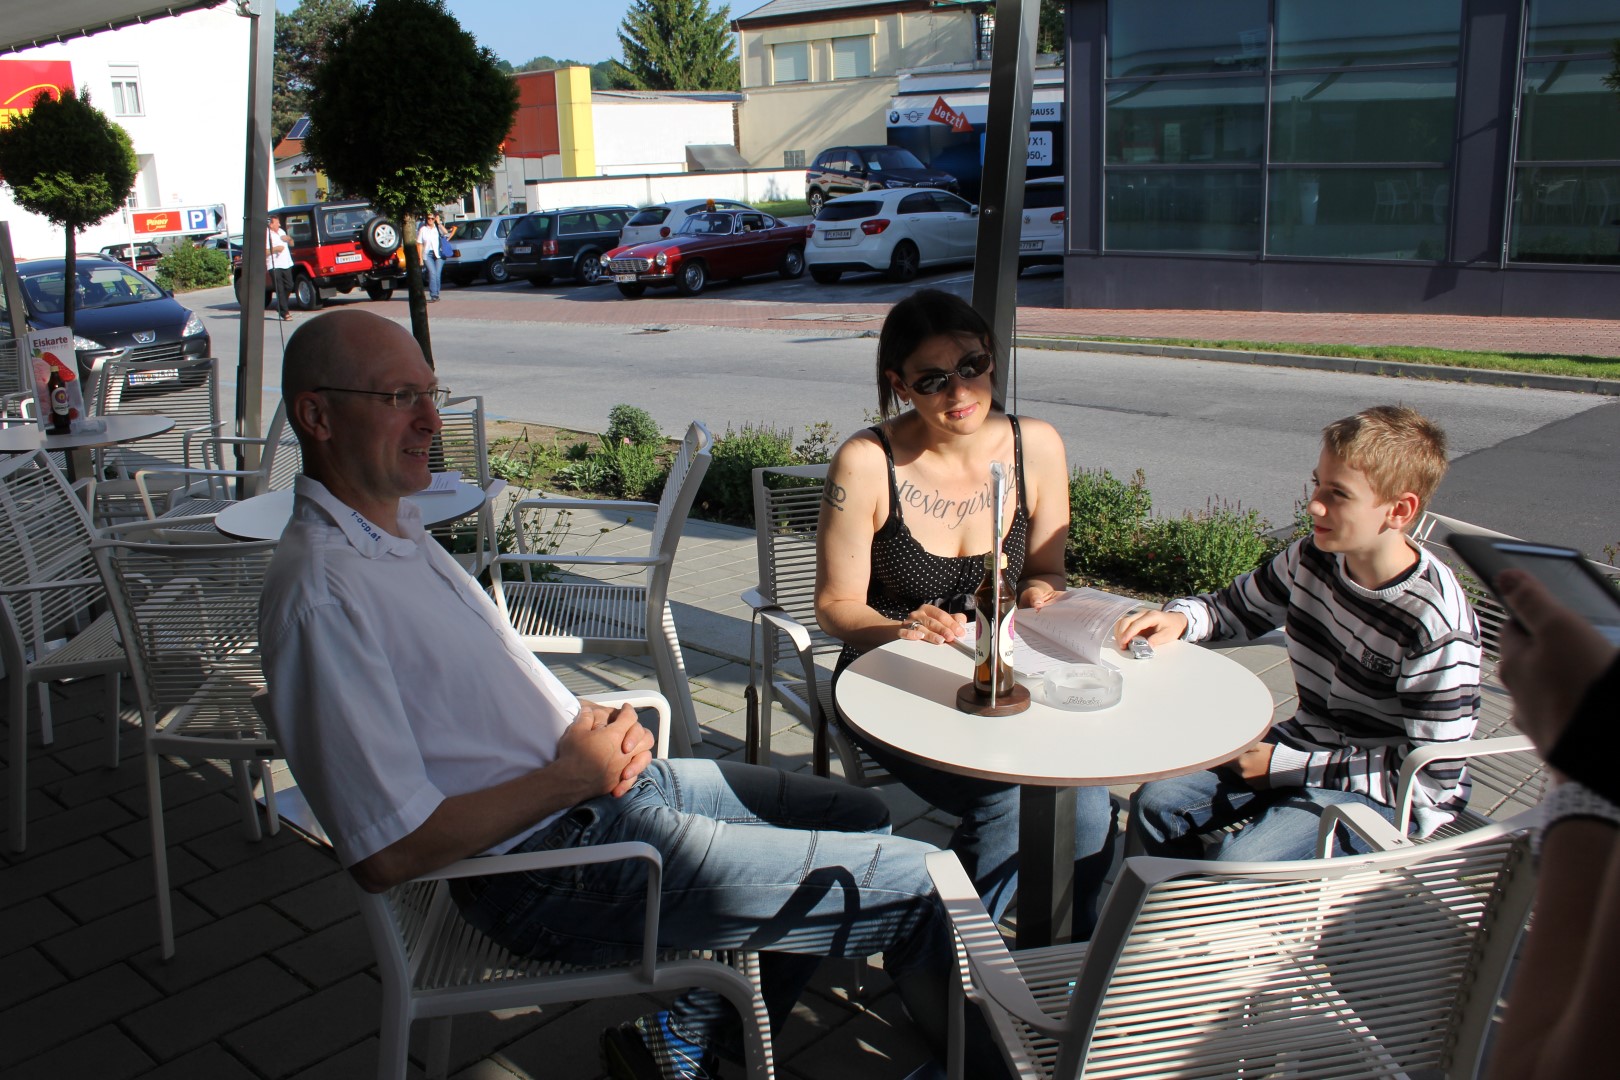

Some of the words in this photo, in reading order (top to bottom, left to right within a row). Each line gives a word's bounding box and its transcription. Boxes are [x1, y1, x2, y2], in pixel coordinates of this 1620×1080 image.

[934, 105, 964, 129] Jetzt!
[146, 218, 169, 226] PENNY
[190, 211, 204, 229] P
[33, 336, 69, 348] Eiskarte
[898, 480, 956, 519] never
[351, 511, 382, 542] 1-ocp.at
